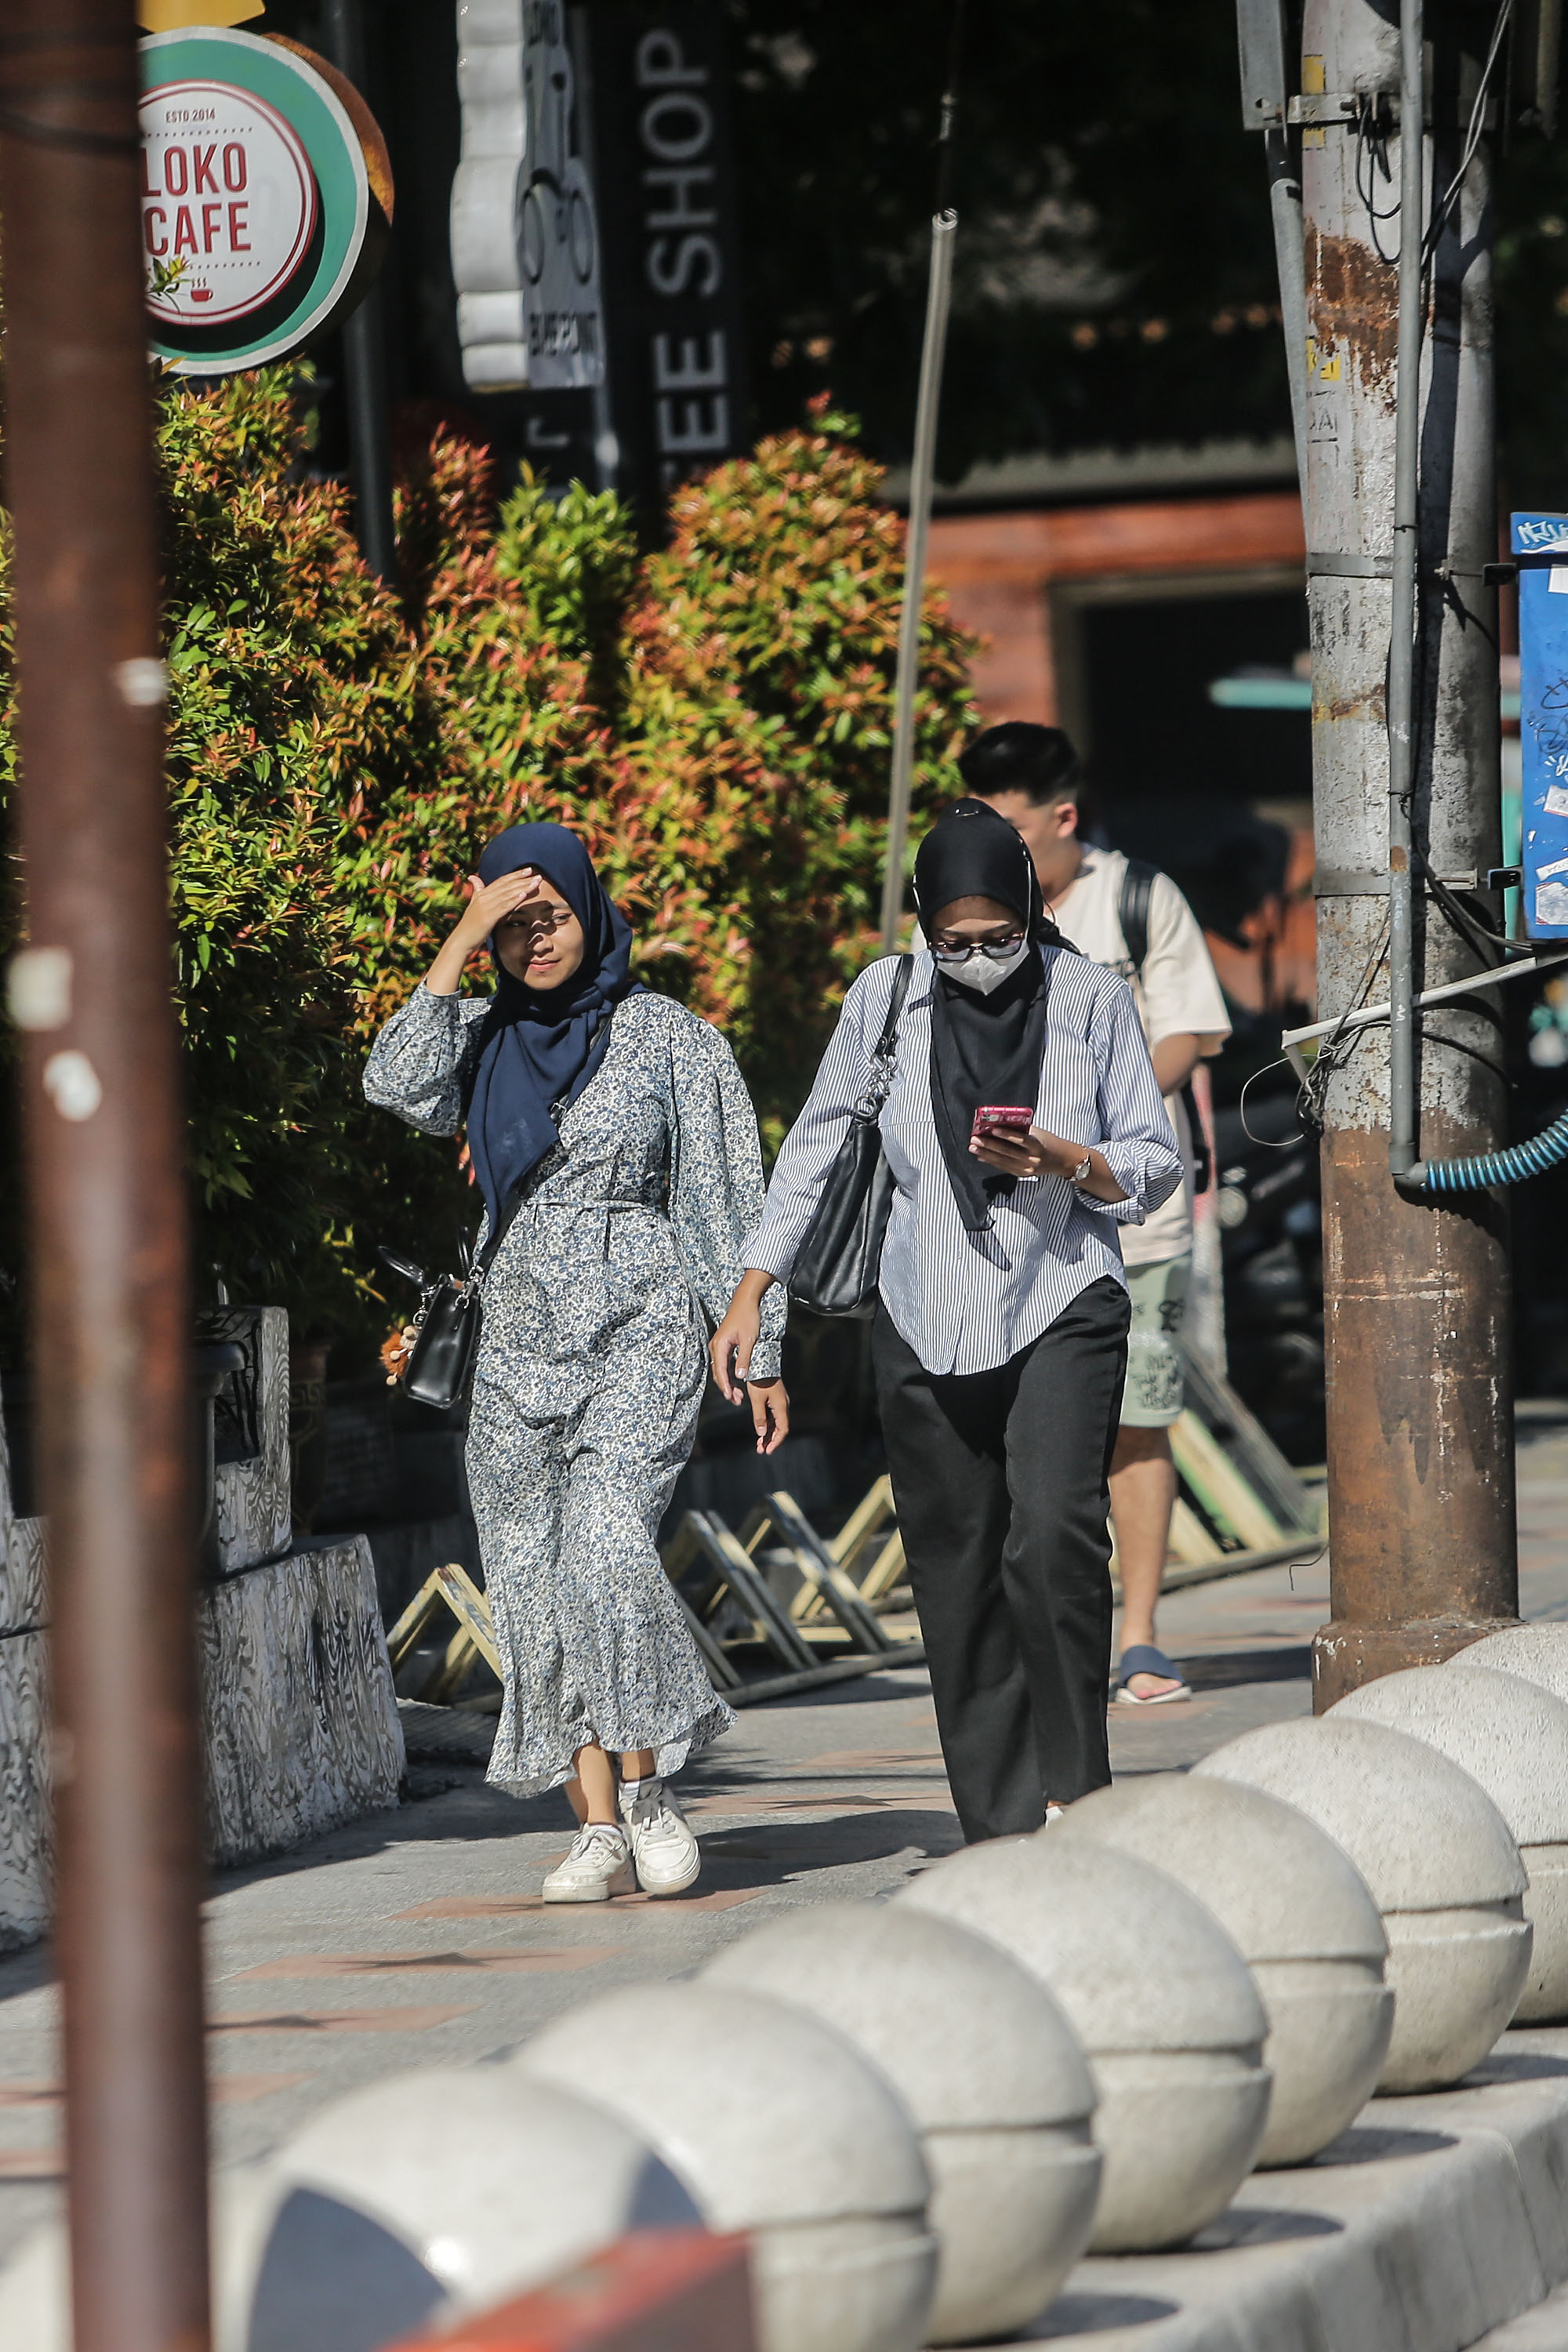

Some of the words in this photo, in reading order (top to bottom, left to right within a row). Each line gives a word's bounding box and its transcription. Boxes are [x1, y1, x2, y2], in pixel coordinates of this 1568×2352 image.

[165, 109, 189, 123] ESTD
[192, 107, 216, 122] 2014
[141, 142, 248, 197] LOKO
[637, 29, 720, 296] SHOP
[144, 201, 252, 256] CAFE
[655, 329, 730, 472] EE
